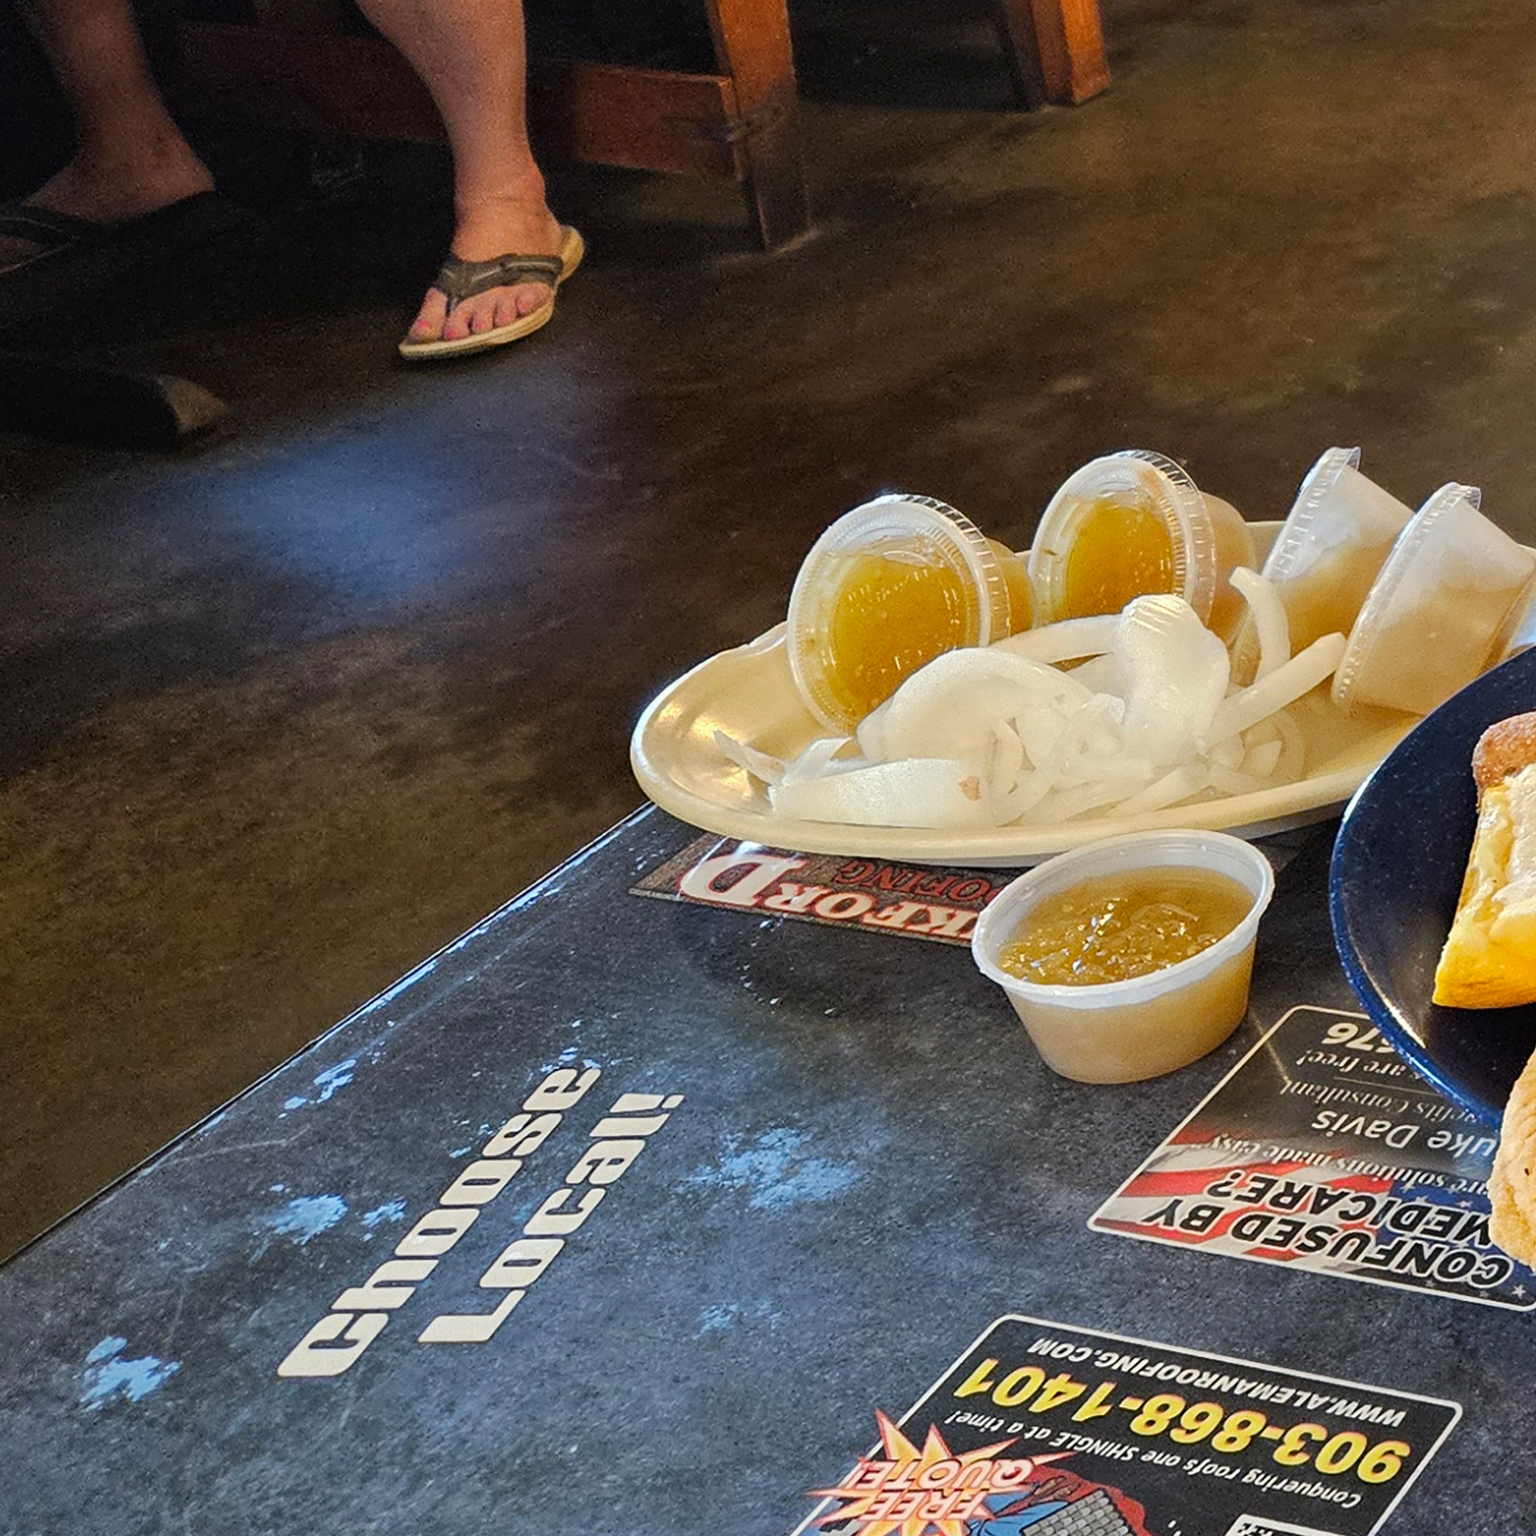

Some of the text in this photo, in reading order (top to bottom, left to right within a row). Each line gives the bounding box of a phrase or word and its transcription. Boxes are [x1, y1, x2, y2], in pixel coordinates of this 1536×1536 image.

[1296, 1049, 1360, 1079] free!
[1363, 1060, 1406, 1079] are
[1279, 1081, 1408, 1115] Consultant
[1262, 1145, 1332, 1168] made
[1311, 1109, 1496, 1159] uke Davis
[1337, 1157, 1445, 1189] solutions
[276, 1068, 601, 1378] Choose
[417, 1092, 686, 1343] Local!
[1206, 1170, 1491, 1248] MEDICARE?
[1140, 1198, 1512, 1288] CONFUSED BY
[1027, 1337, 1406, 1427] WWW.ALEMANROOFING.COM
[952, 1356, 1410, 1484] 903-868-1401
[844, 1455, 1034, 1490] QUOTE!
[944, 1408, 1362, 1509] Conquering roofs one SHINGLE at a time!
[854, 1490, 987, 1522] FREE
